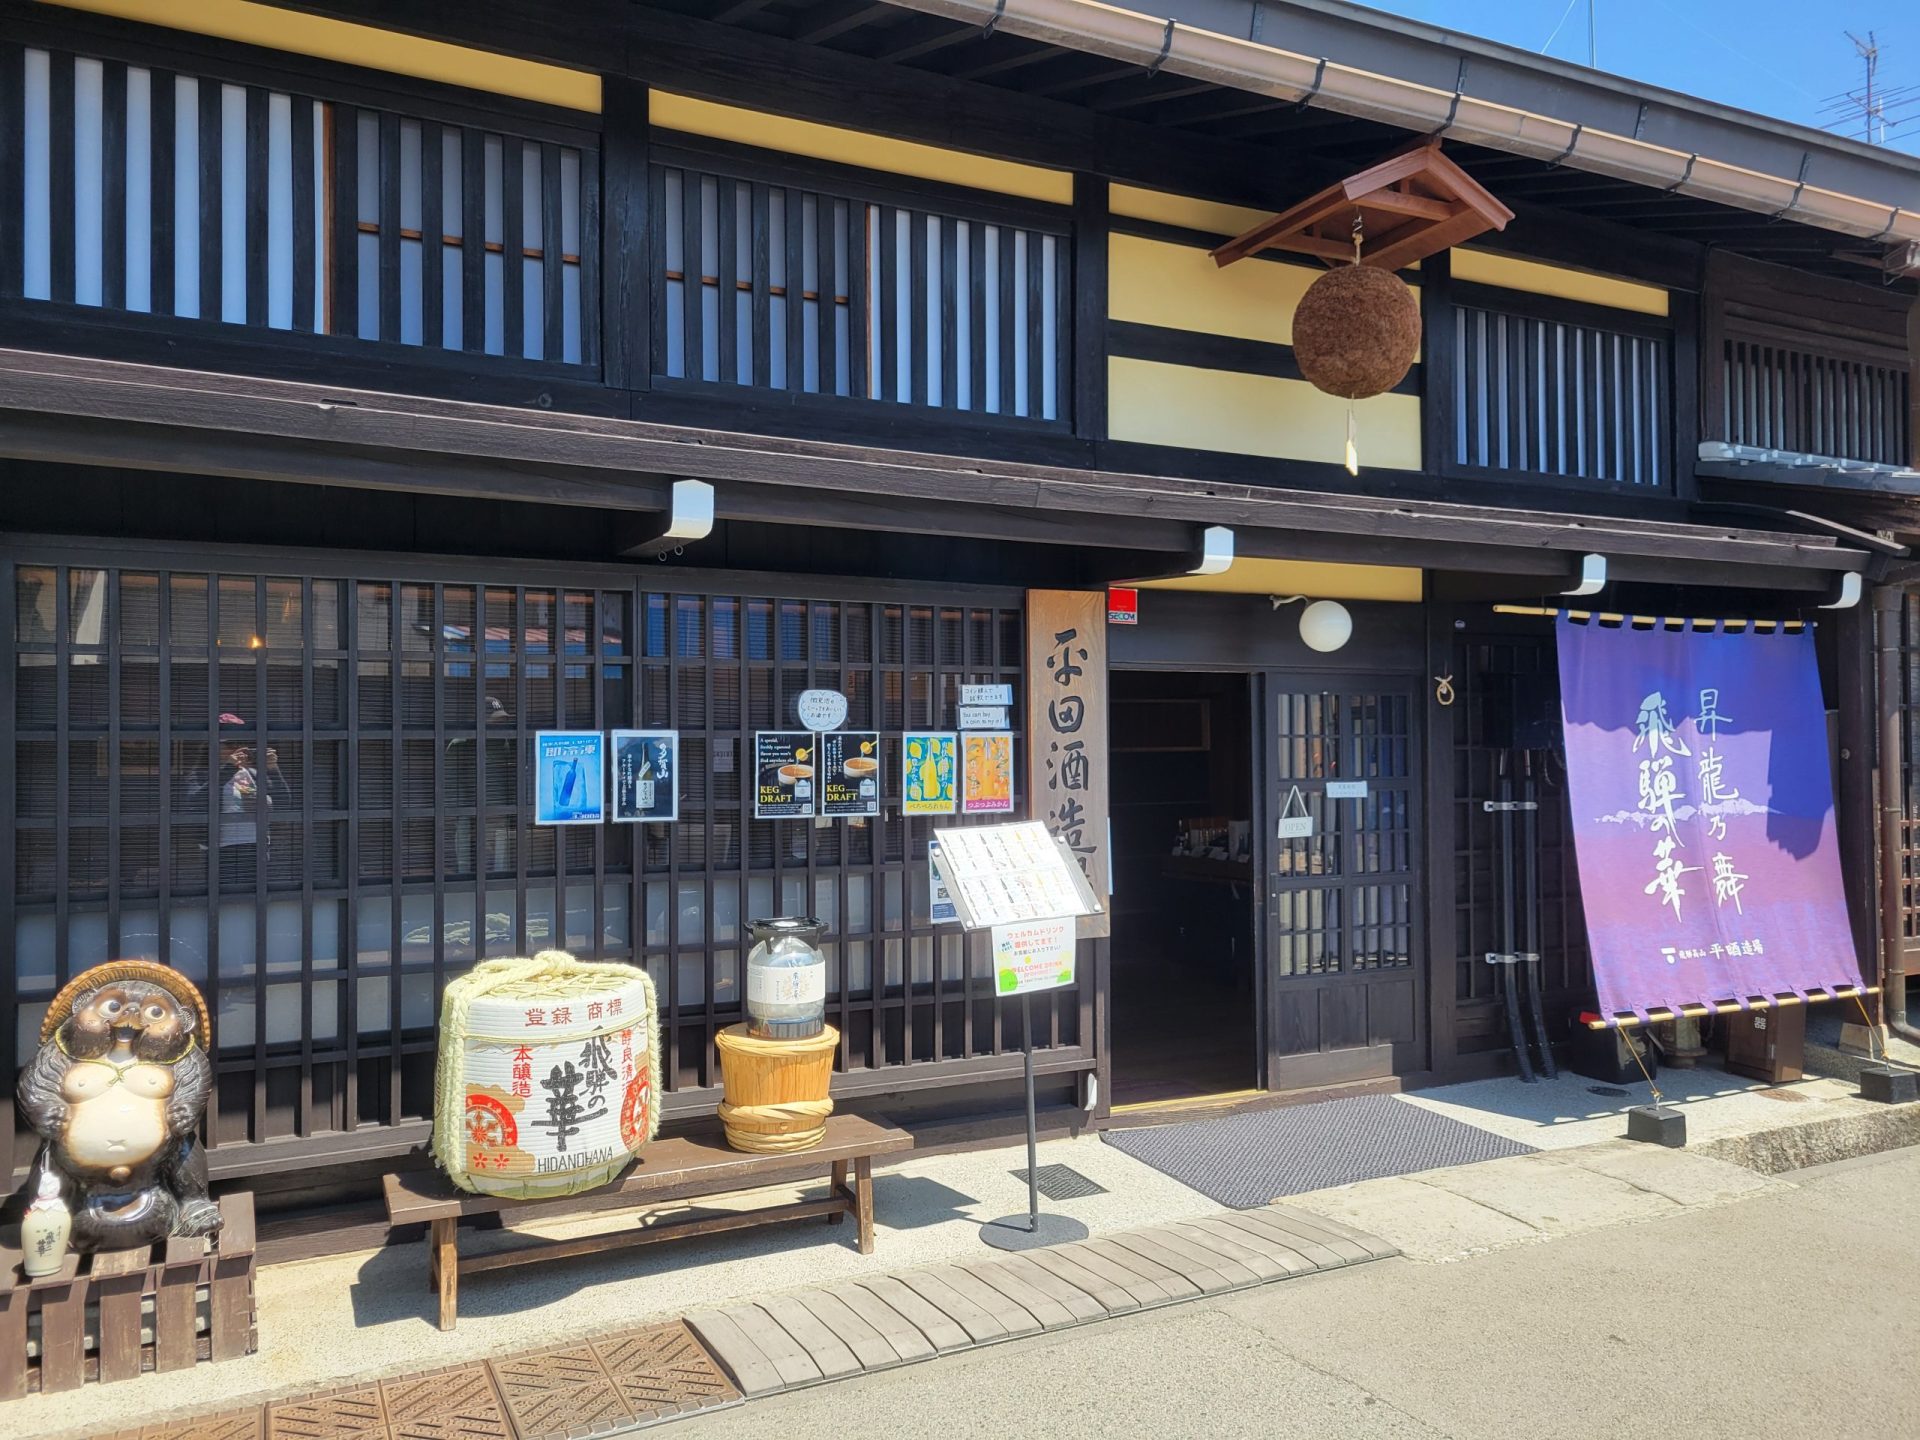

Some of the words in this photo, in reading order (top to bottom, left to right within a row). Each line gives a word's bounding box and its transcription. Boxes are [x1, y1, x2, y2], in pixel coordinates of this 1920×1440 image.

[1109, 612, 1135, 620] SECOM
[1047, 628, 1097, 888] 平田酒造
[760, 786, 780, 794] KEG
[826, 784, 845, 792] KEG
[760, 794, 792, 803] DRAFT
[826, 793, 858, 801] DRAFT
[1695, 688, 1749, 915] 昇龍乃舞
[1633, 691, 1705, 923] 飛騨の華
[1285, 822, 1307, 831] OPEN
[524, 1006, 572, 1027] 登録
[587, 998, 623, 1019] 商標
[537, 1146, 614, 1173] HIDANOHANA
